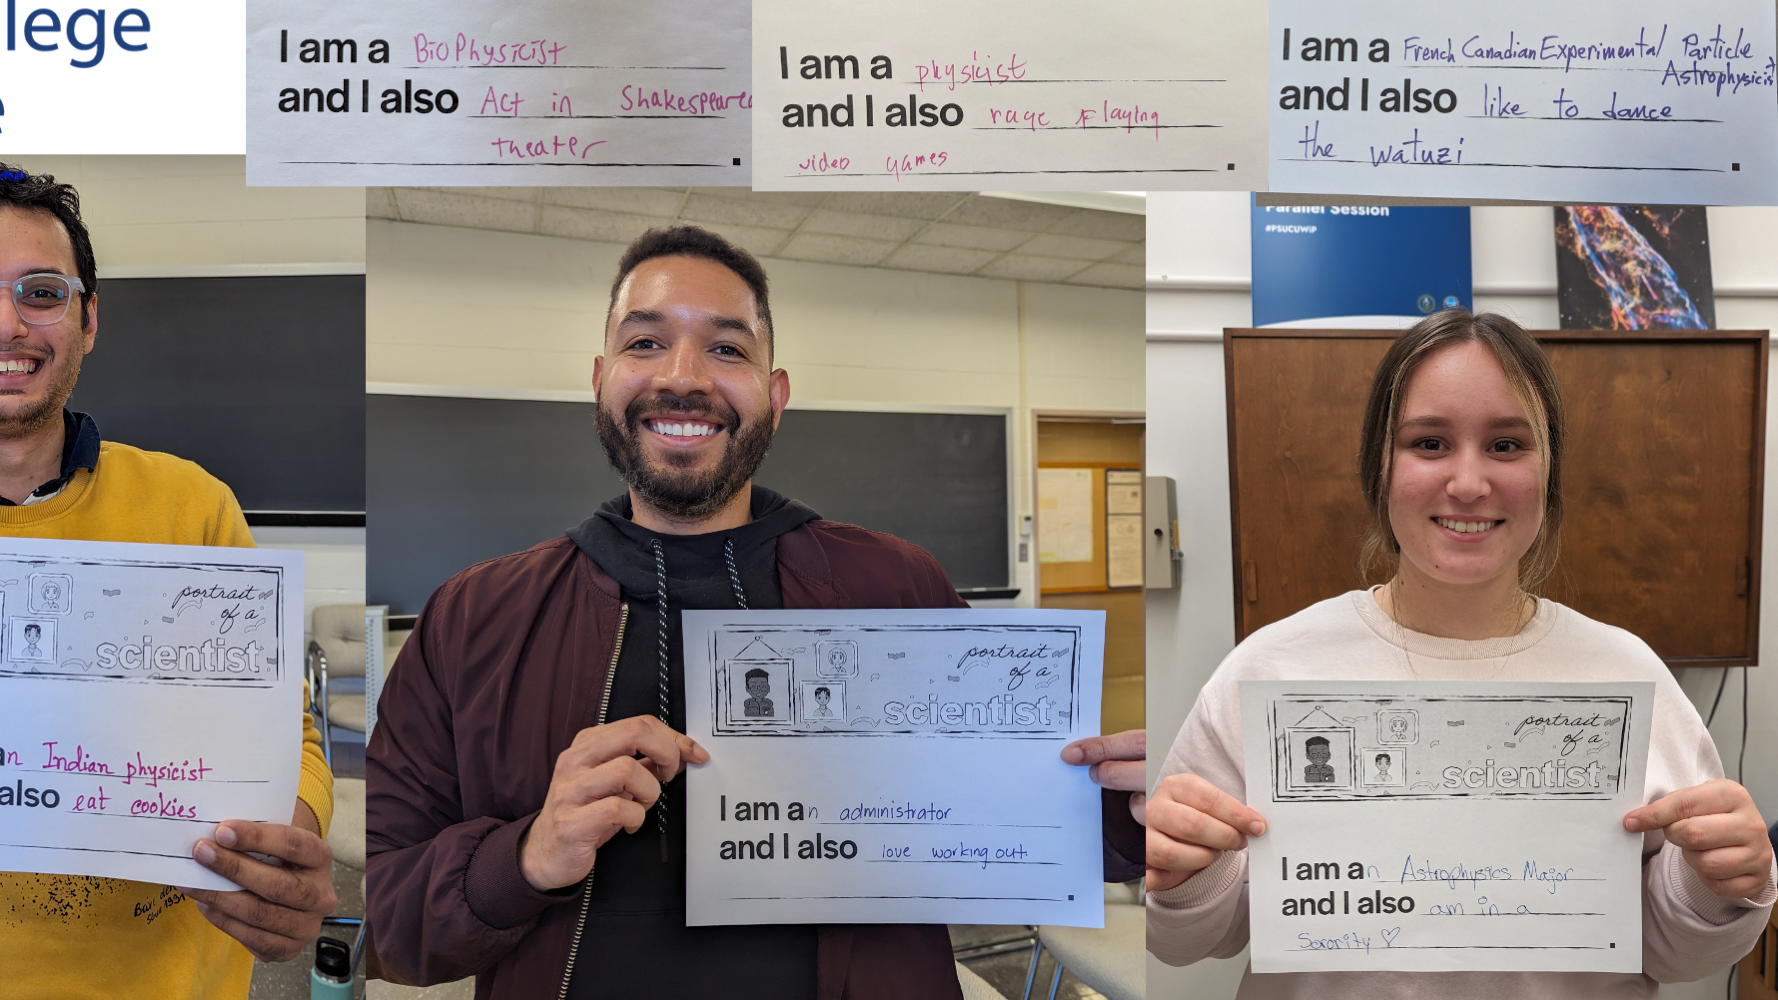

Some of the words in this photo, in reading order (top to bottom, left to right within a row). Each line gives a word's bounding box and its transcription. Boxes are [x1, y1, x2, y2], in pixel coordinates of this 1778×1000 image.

[1282, 28, 1290, 61] I
[1300, 36, 1359, 62] am
[1368, 36, 1390, 62] a
[1403, 35, 1456, 65] French
[1461, 30, 1538, 62] Canadian
[1540, 24, 1669, 73] Experimental
[1682, 26, 1755, 61] Particle
[479, 85, 526, 118] Act
[551, 92, 573, 117] in
[1278, 79, 1350, 112] and
[1361, 79, 1368, 111] I
[1379, 77, 1458, 114] also
[1483, 85, 1528, 118] like
[1553, 87, 1580, 120] to
[1602, 91, 1674, 121] dance
[490, 134, 608, 160] theater
[1298, 119, 1339, 162] the
[798, 152, 851, 173] video
[885, 150, 949, 182] games
[1330, 206, 1390, 216] Session
[42, 741, 115, 776] Indian
[126, 752, 214, 787] physicist
[71, 787, 112, 812] eat
[130, 791, 198, 820] cookies
[839, 797, 953, 821] administrator
[881, 841, 912, 859] love
[931, 841, 989, 870] working
[1522, 860, 1574, 895] Major
[1429, 902, 1465, 916] am
[1477, 896, 1500, 917] in
[1516, 904, 1531, 916] a
[1297, 932, 1372, 955] Sorority
